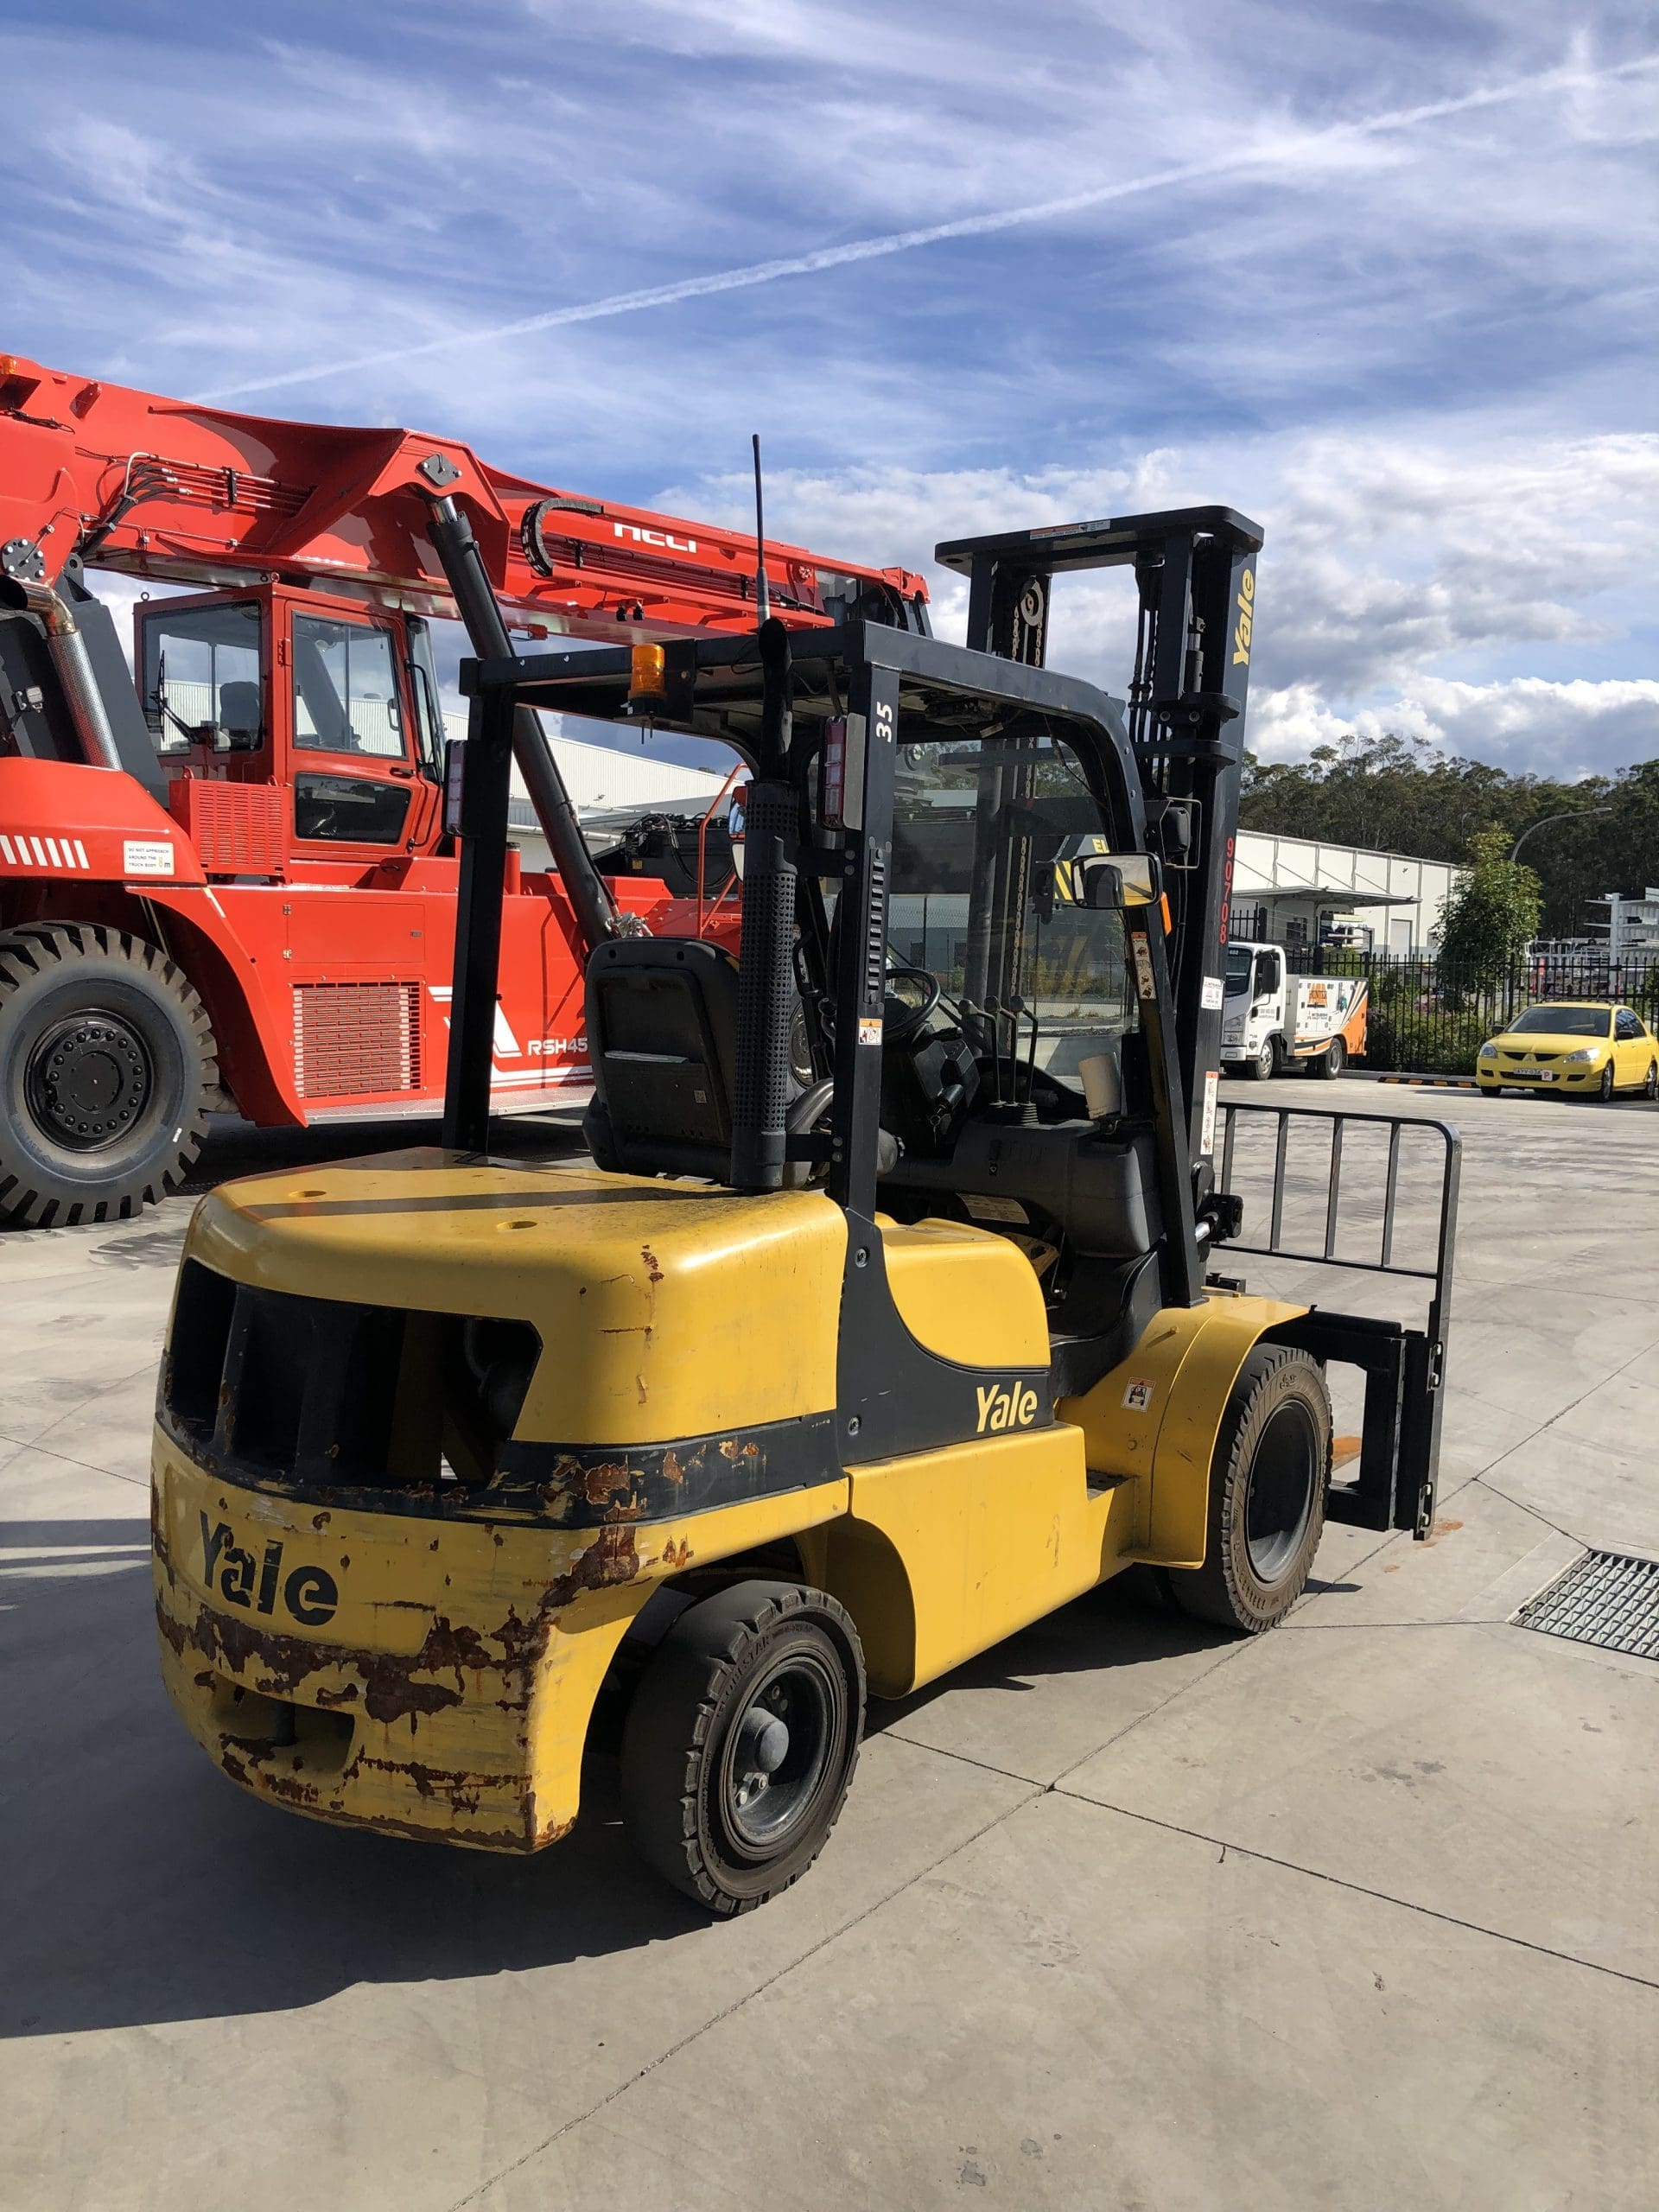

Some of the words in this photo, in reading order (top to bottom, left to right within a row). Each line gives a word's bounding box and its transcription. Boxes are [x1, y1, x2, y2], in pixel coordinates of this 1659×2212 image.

[1233, 569, 1255, 665] Yale
[876, 701, 893, 743] 35
[1219, 837, 1235, 944] 90708
[976, 1381, 1038, 1433] Yale
[200, 1510, 339, 1626] Yale
